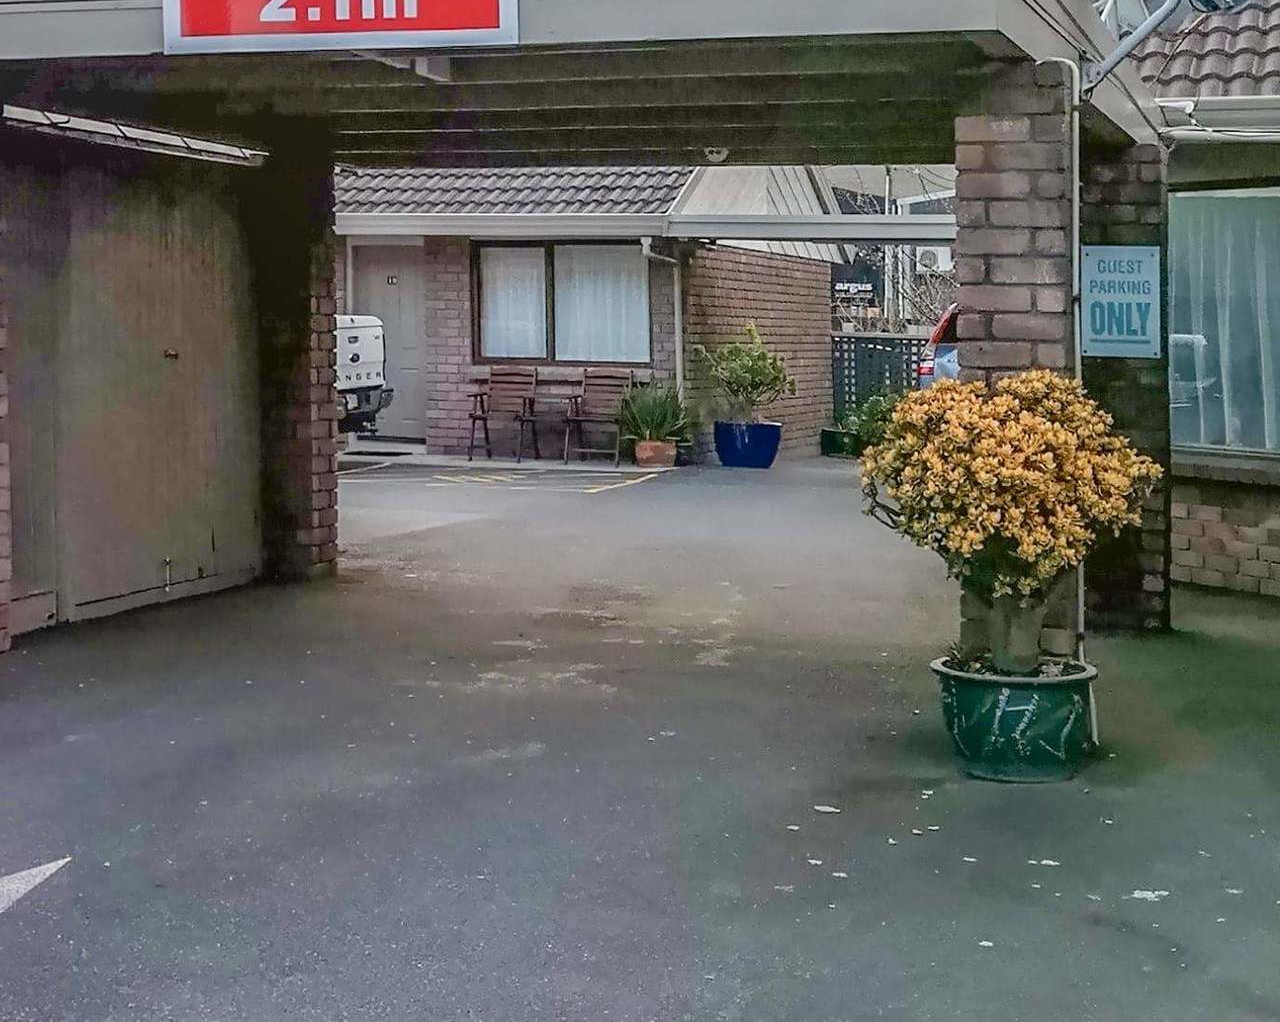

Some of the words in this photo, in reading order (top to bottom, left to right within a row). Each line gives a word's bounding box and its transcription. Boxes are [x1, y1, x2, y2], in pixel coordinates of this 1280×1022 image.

[1097, 259, 1144, 274] GUEST
[1089, 280, 1152, 295] PARKING
[1090, 301, 1152, 337] ONLY
